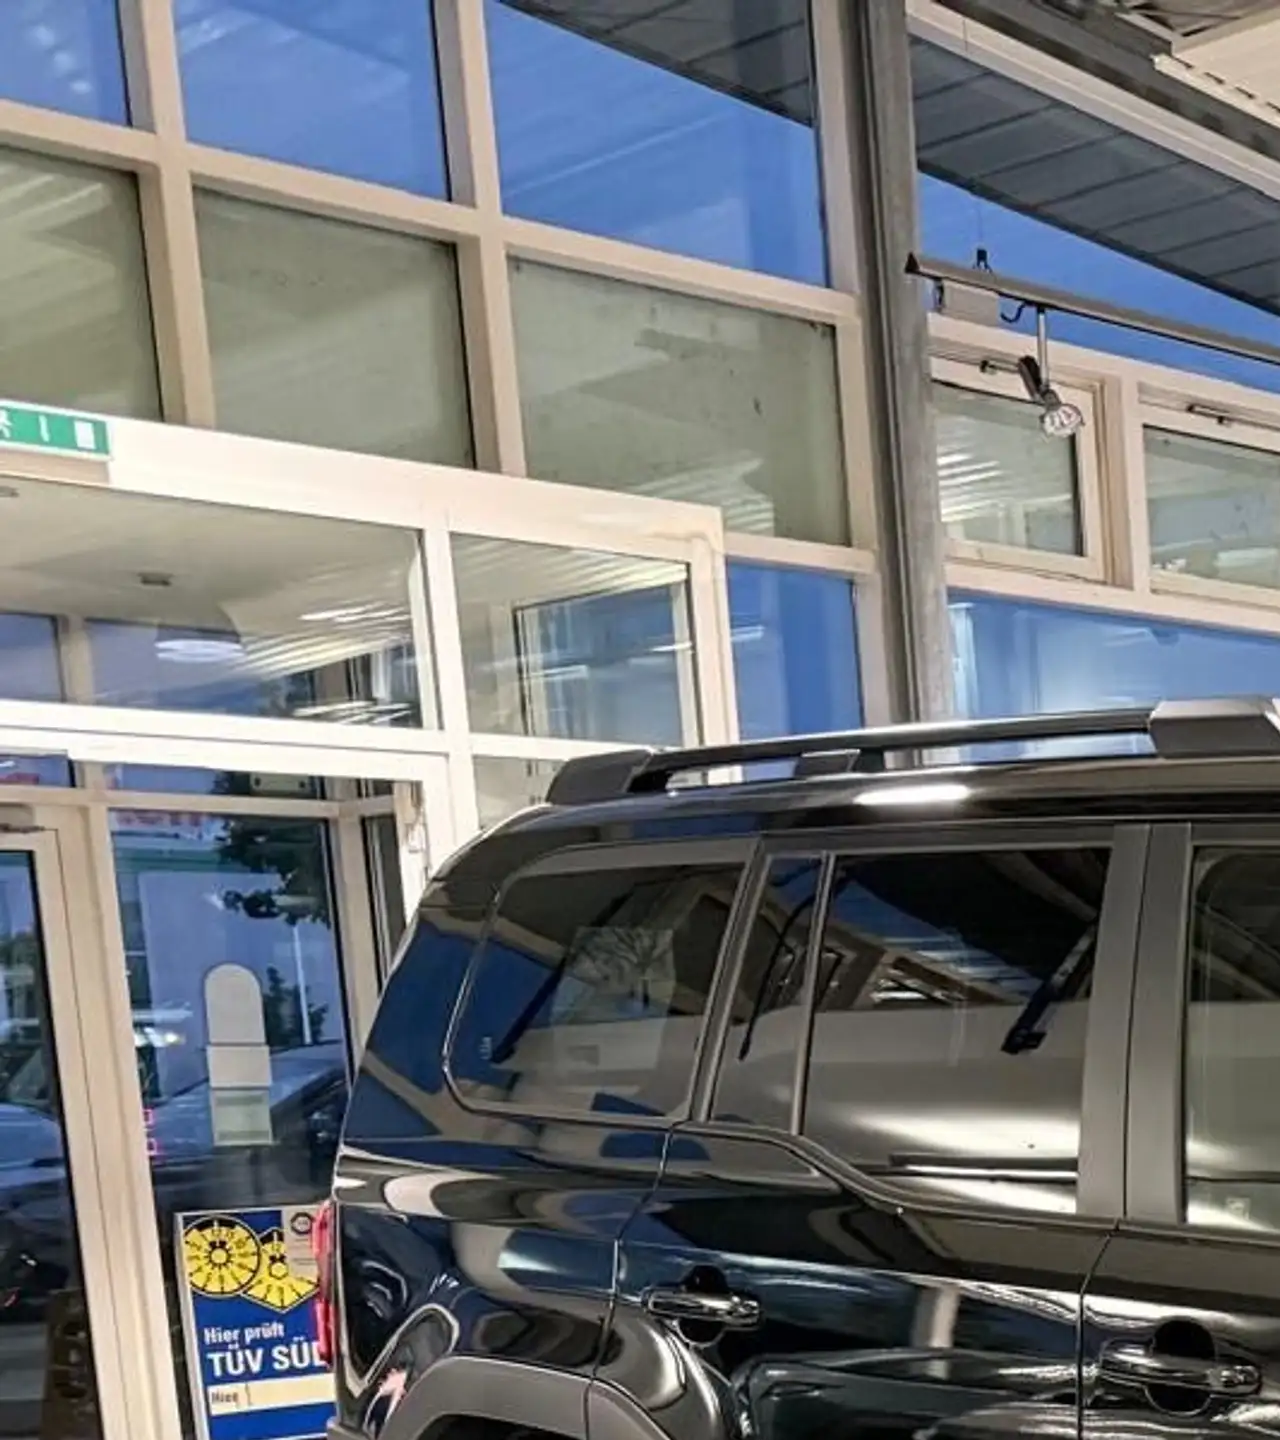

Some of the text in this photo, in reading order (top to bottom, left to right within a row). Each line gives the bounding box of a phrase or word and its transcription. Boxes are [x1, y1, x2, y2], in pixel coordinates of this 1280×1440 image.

[203, 1322, 285, 1344] Hier prüft
[207, 1344, 266, 1378] TÜV
